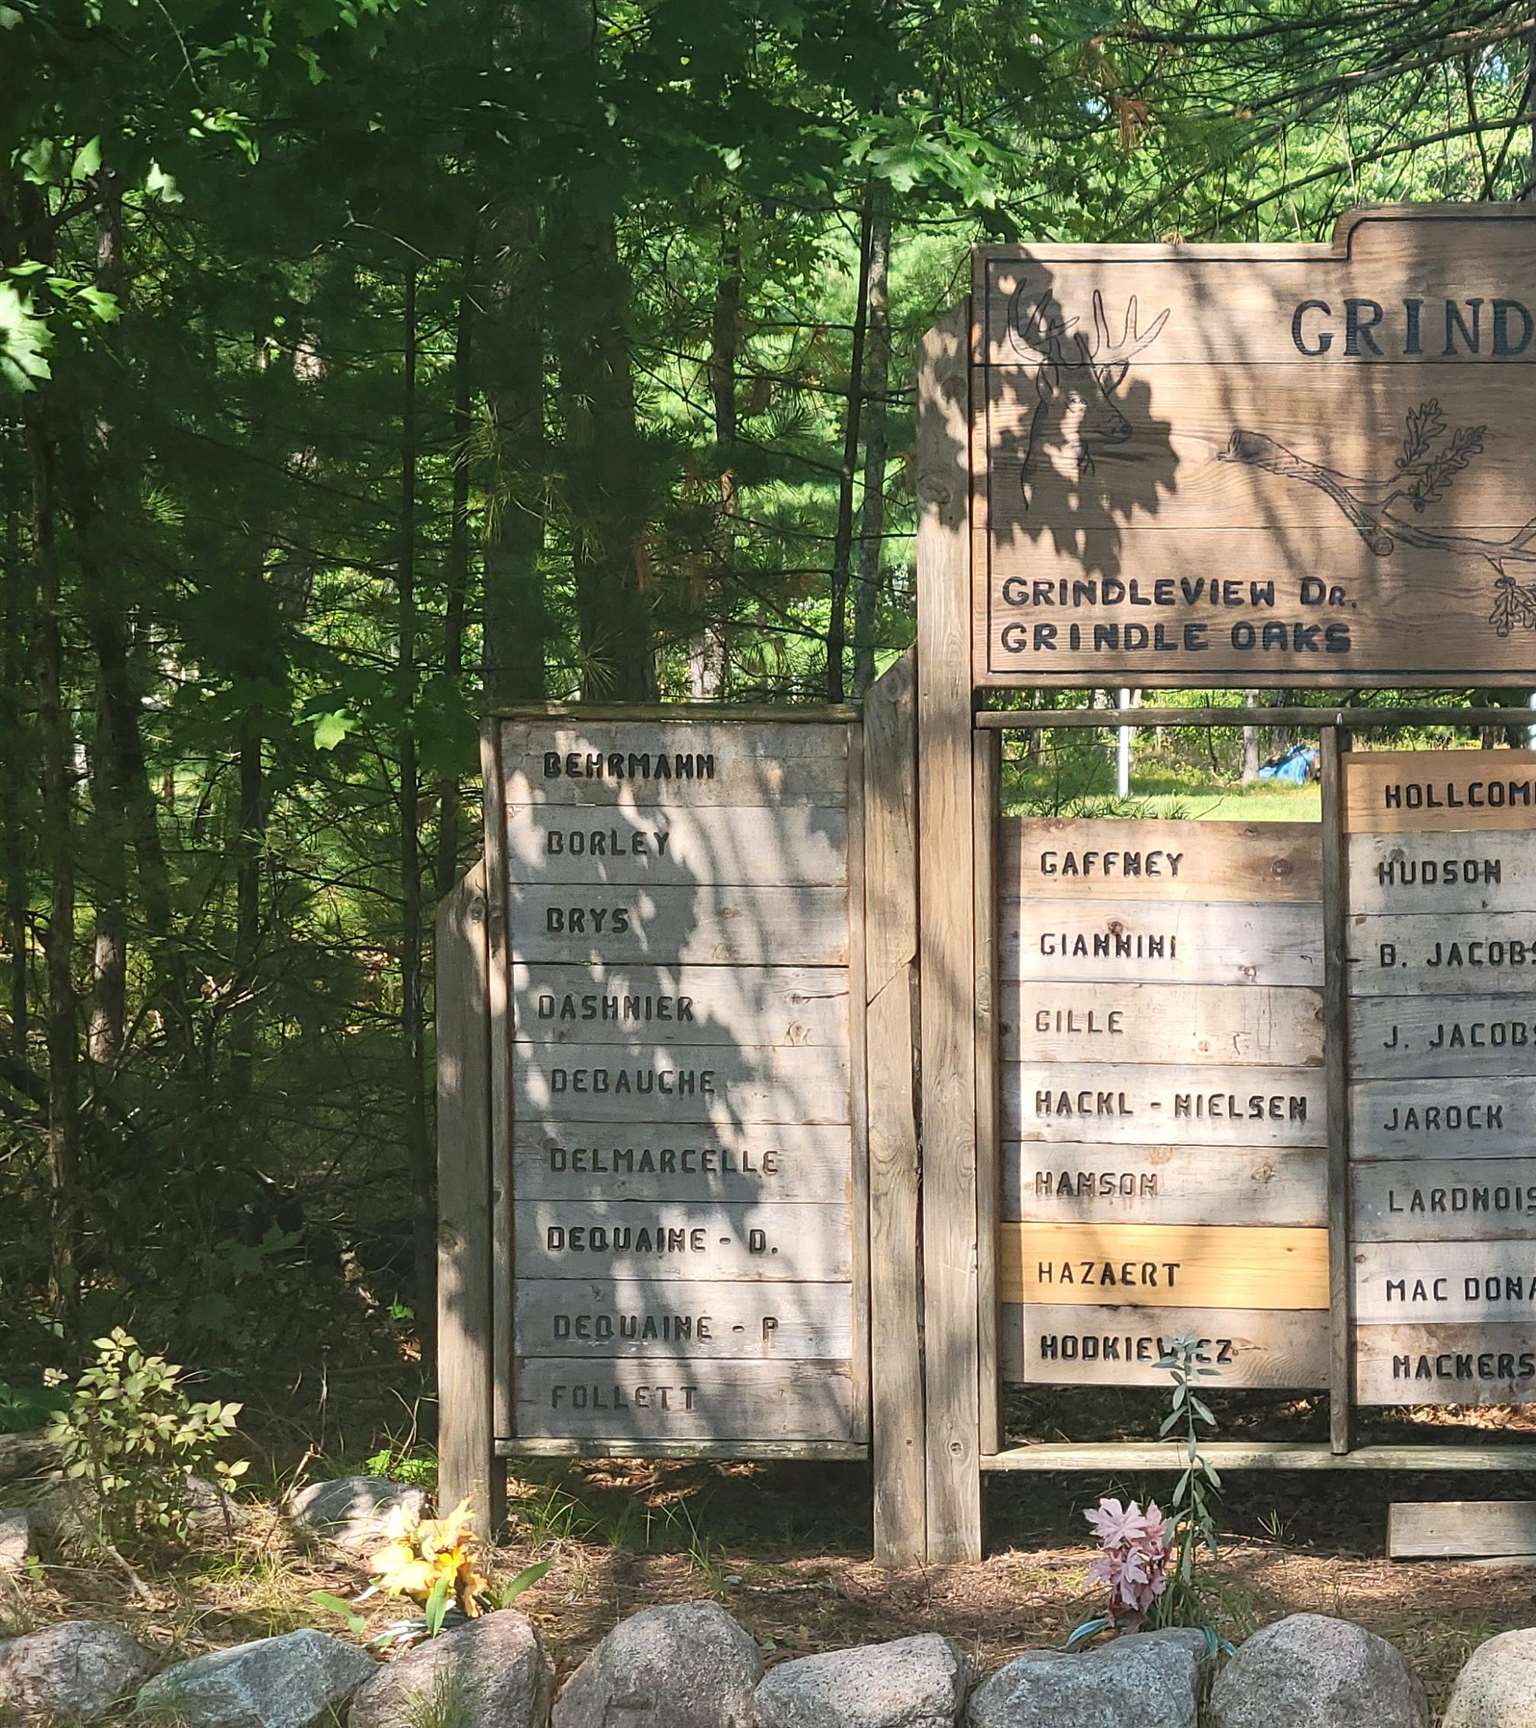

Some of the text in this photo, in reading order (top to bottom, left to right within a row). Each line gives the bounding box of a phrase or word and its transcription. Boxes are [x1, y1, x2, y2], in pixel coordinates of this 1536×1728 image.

[1002, 576, 1275, 607] GRINDLEVIEW
[1001, 621, 1351, 653] GRINDLE OAKS
[544, 752, 714, 779] BEHRMANN
[547, 830, 670, 856] BORLEY
[1040, 851, 1184, 877] GAFFNEY
[1378, 859, 1502, 886] HUDSON
[546, 908, 629, 933] BRYS
[1040, 933, 1177, 958] GIANNINI
[1380, 944, 1407, 968] B.
[538, 994, 694, 1021] DASHNIER
[1035, 1010, 1124, 1034] GILLE
[1383, 1026, 1409, 1049] J.
[551, 1068, 716, 1095] DEBAUCHE
[1036, 1090, 1134, 1117] HACKL
[1175, 1093, 1308, 1121] NIELSEN
[1384, 1105, 1504, 1131] JAROCK
[550, 1148, 778, 1175] DELMARCELLE
[1036, 1171, 1158, 1197] HANSON
[547, 1226, 707, 1252] DEQUAINE
[749, 1228, 779, 1254] D.
[1038, 1262, 1181, 1287] HAZAERT
[1386, 1279, 1448, 1301] MAC
[553, 1314, 712, 1341] DEQUAINE
[762, 1316, 778, 1342] P
[1393, 1353, 1536, 1380] NACKERS
[551, 1385, 698, 1410] FOLLETT
